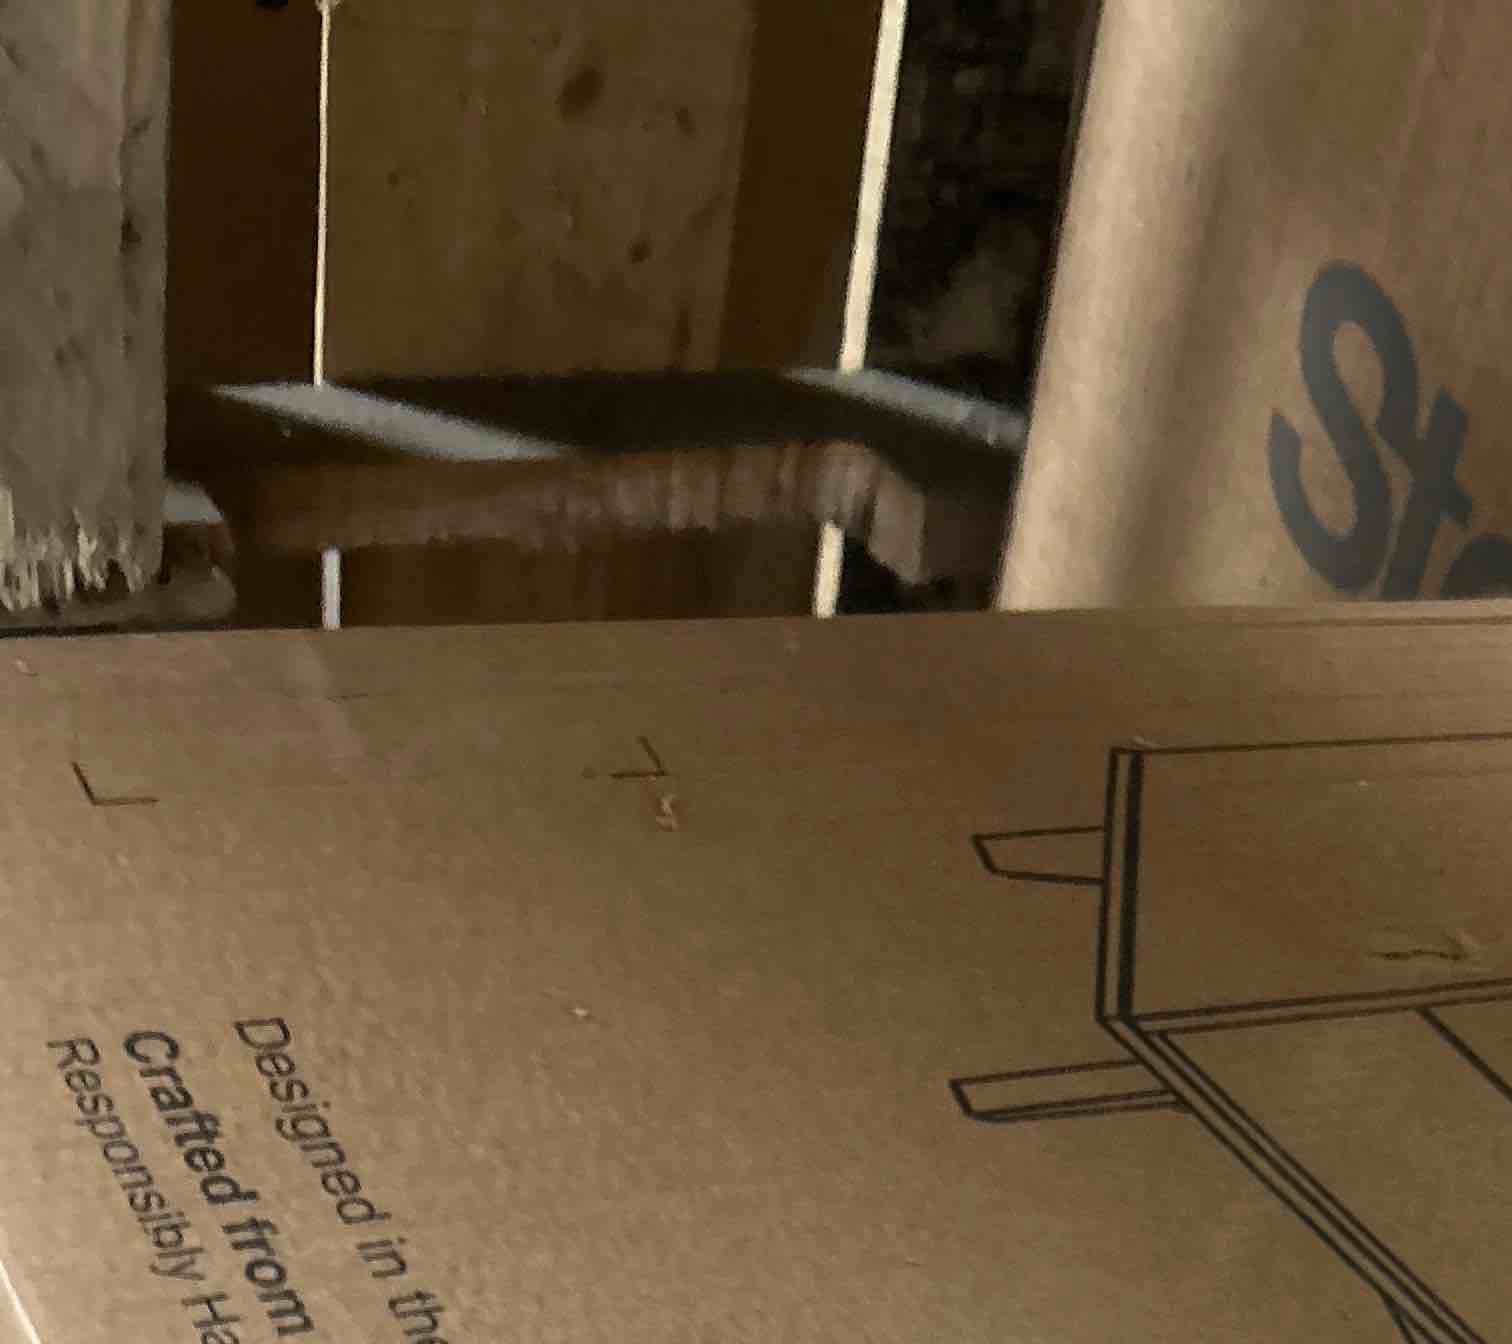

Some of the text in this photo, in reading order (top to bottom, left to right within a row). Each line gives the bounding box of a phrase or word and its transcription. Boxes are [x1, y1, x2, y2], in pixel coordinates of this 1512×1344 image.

[46, 1037, 205, 1280] Responsibly
[123, 1030, 261, 1205] Crafted
[221, 1216, 315, 1337] from
[232, 1017, 392, 1225] Designed
[356, 1237, 407, 1279] in
